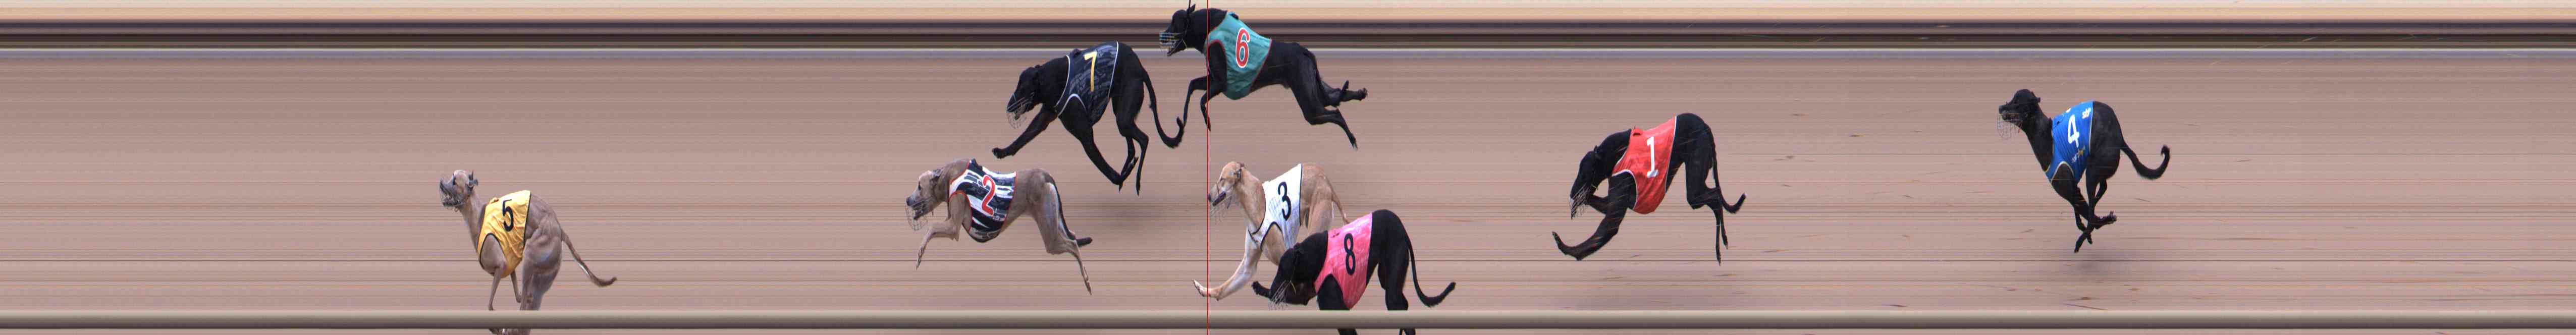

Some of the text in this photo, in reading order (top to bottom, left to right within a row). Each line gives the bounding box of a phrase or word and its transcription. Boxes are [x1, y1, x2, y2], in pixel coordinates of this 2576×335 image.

[1236, 27, 1251, 68] 6
[1084, 51, 1097, 92] 7
[2068, 115, 2080, 148] 4
[1646, 136, 1659, 178] 1
[502, 199, 514, 232] 5
[982, 175, 996, 216] 2
[1278, 182, 1291, 221] 3
[1344, 233, 1356, 275] 8
